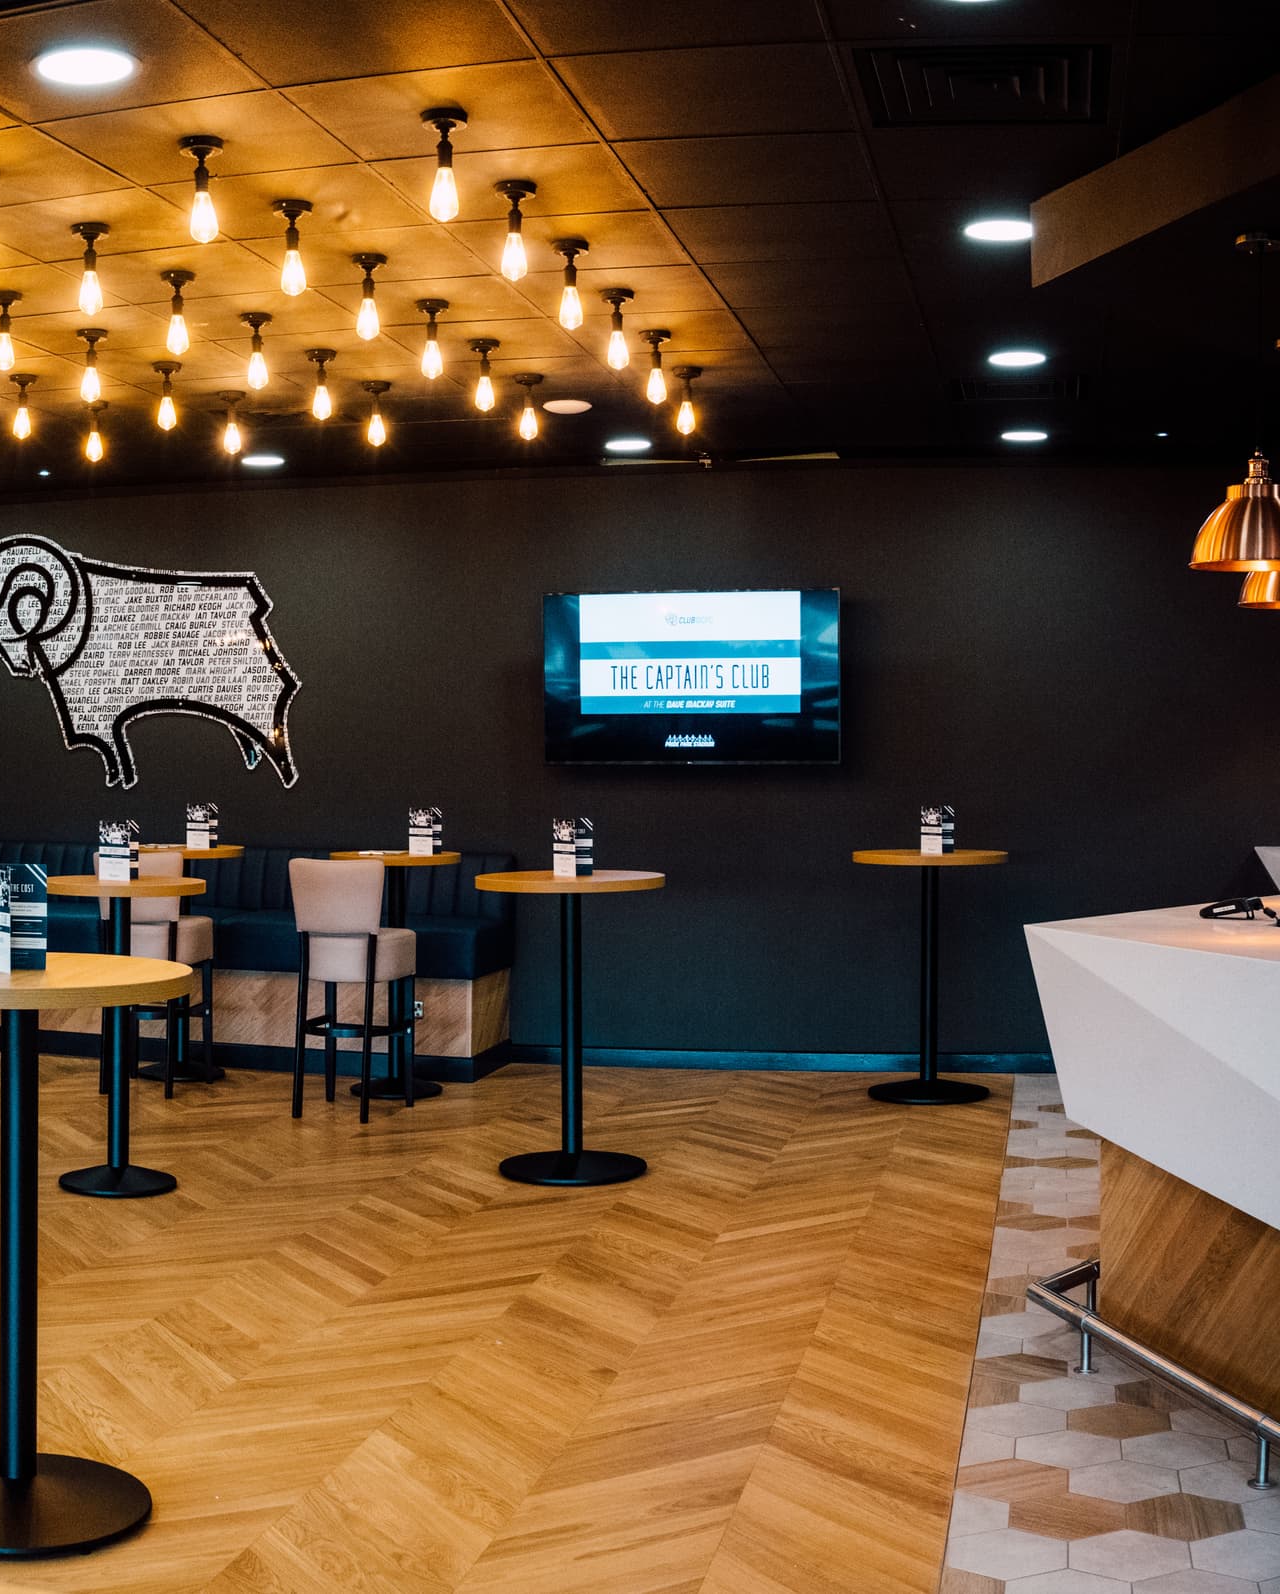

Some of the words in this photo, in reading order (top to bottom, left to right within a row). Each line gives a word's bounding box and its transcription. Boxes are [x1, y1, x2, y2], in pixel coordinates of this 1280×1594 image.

[125, 596, 143, 604] JAKE
[145, 594, 173, 603] BUXTON
[164, 603, 196, 612] RICHARD
[198, 602, 222, 610] KEOGH
[195, 612, 208, 620] IAN
[210, 611, 236, 619] TAYLOR
[165, 622, 187, 630] CRAIG
[189, 620, 217, 629] BURLEY
[144, 631, 170, 640] ROBBIE
[172, 630, 200, 639] SAVAGE
[117, 641, 131, 649] ROB
[134, 641, 146, 649] LEE
[203, 639, 225, 647] CHRS
[84, 651, 104, 660] BAIRD
[179, 648, 210, 656] MICHAEL
[213, 647, 248, 656] JOHNSON
[163, 658, 175, 667] IAN
[178, 657, 204, 666] TAYLOR
[124, 668, 152, 677] DARREN
[155, 667, 181, 676] MOORE
[242, 665, 267, 674] JASON
[120, 677, 139, 686] MATT
[142, 677, 168, 685] OAKLEY
[252, 674, 279, 683] ROBBIE
[610, 665, 638, 690] THE
[644, 664, 724, 690] CAPTAIN'S
[731, 663, 771, 690] CLUB
[88, 687, 100, 695] LEE
[103, 686, 134, 695] CARSLEY
[187, 685, 213, 693] CURTIS
[216, 684, 242, 693] DAVIES
[246, 693, 269, 702] CHRIS
[88, 704, 121, 713] JOHNSON
[643, 700, 653, 709] AT
[654, 700, 666, 709] THE
[666, 700, 685, 709] DAVE
[685, 700, 714, 709] MACKAY
[715, 699, 736, 709] SUITE
[79, 714, 95, 722] PAUL
[76, 723, 99, 731] KENNA
